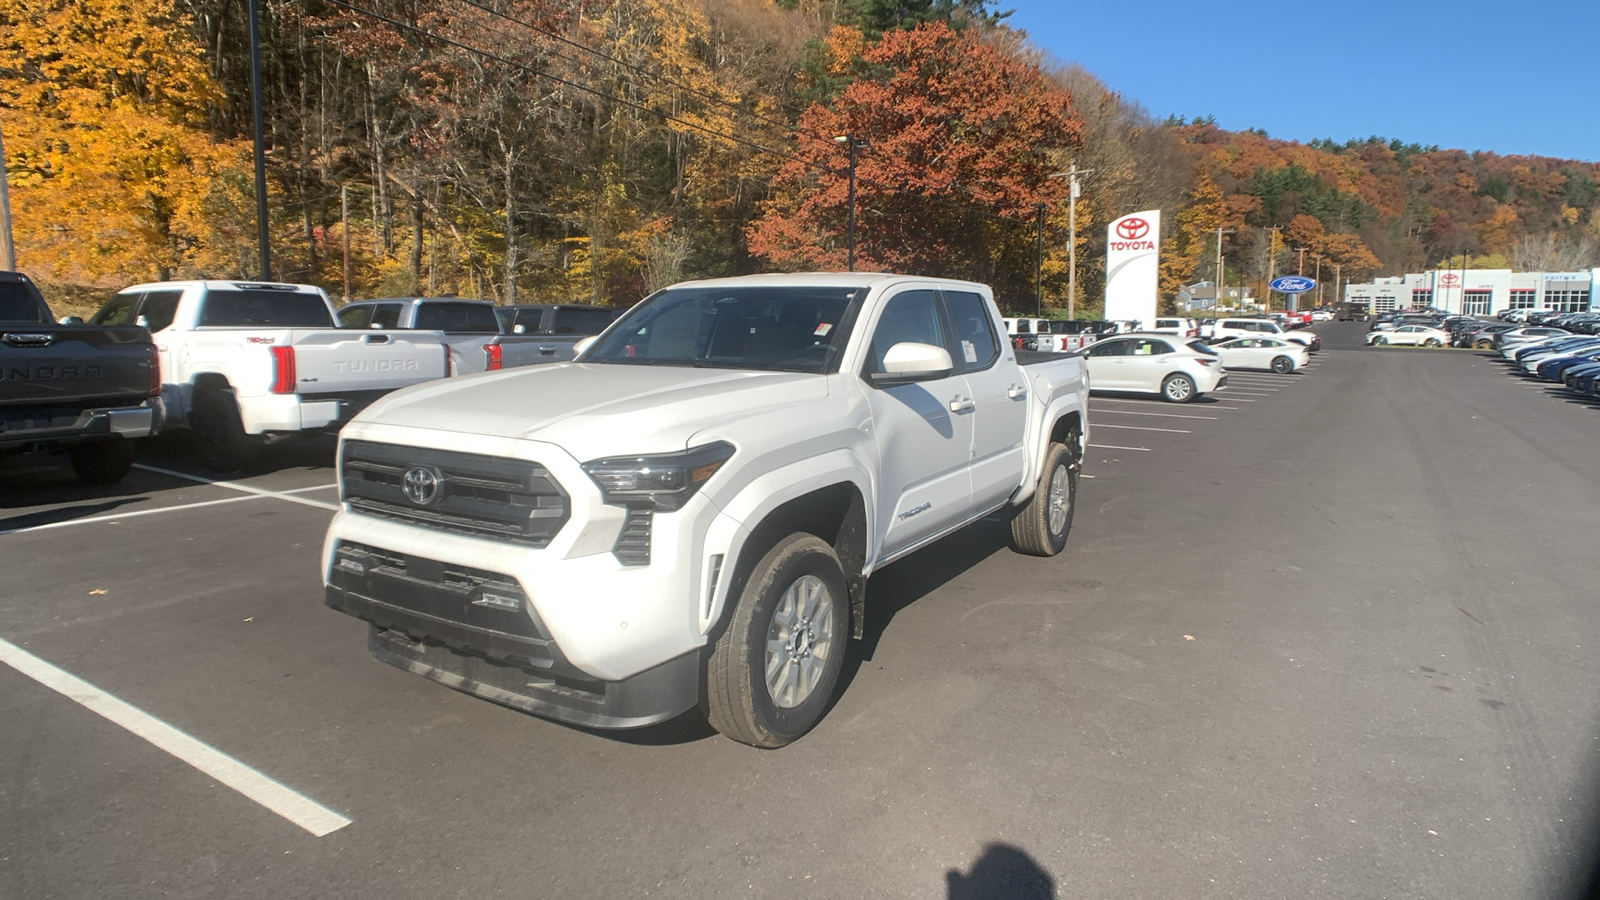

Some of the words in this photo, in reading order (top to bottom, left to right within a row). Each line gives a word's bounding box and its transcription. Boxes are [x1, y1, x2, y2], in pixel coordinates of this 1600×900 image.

[1110, 241, 1155, 251] TOYOTA
[1278, 279, 1307, 290] Ford
[0, 365, 102, 381] NDRA
[332, 359, 419, 373] TUNDRA
[898, 502, 931, 521] TACOMA
